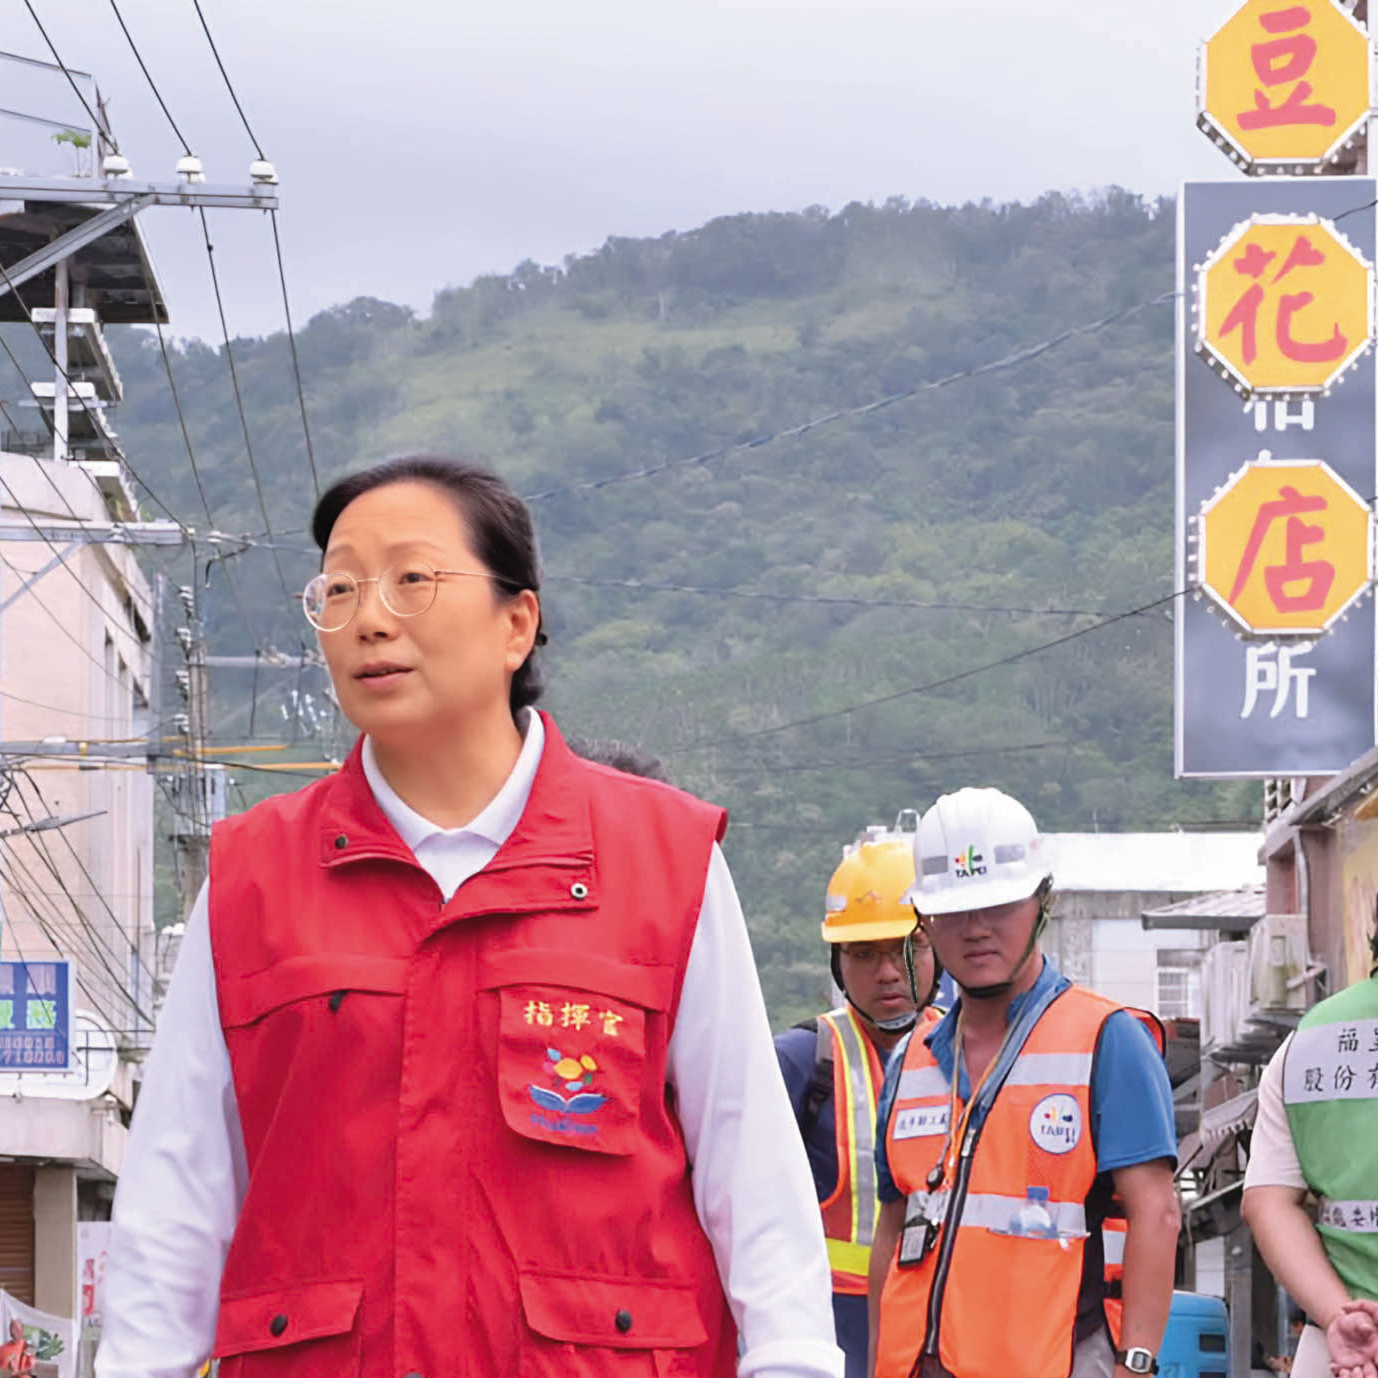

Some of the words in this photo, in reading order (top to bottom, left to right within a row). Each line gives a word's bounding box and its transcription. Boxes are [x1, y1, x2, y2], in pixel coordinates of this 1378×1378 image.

[1219, 5, 1348, 614] 豆花店
[523, 1000, 623, 1036] 指揮官
